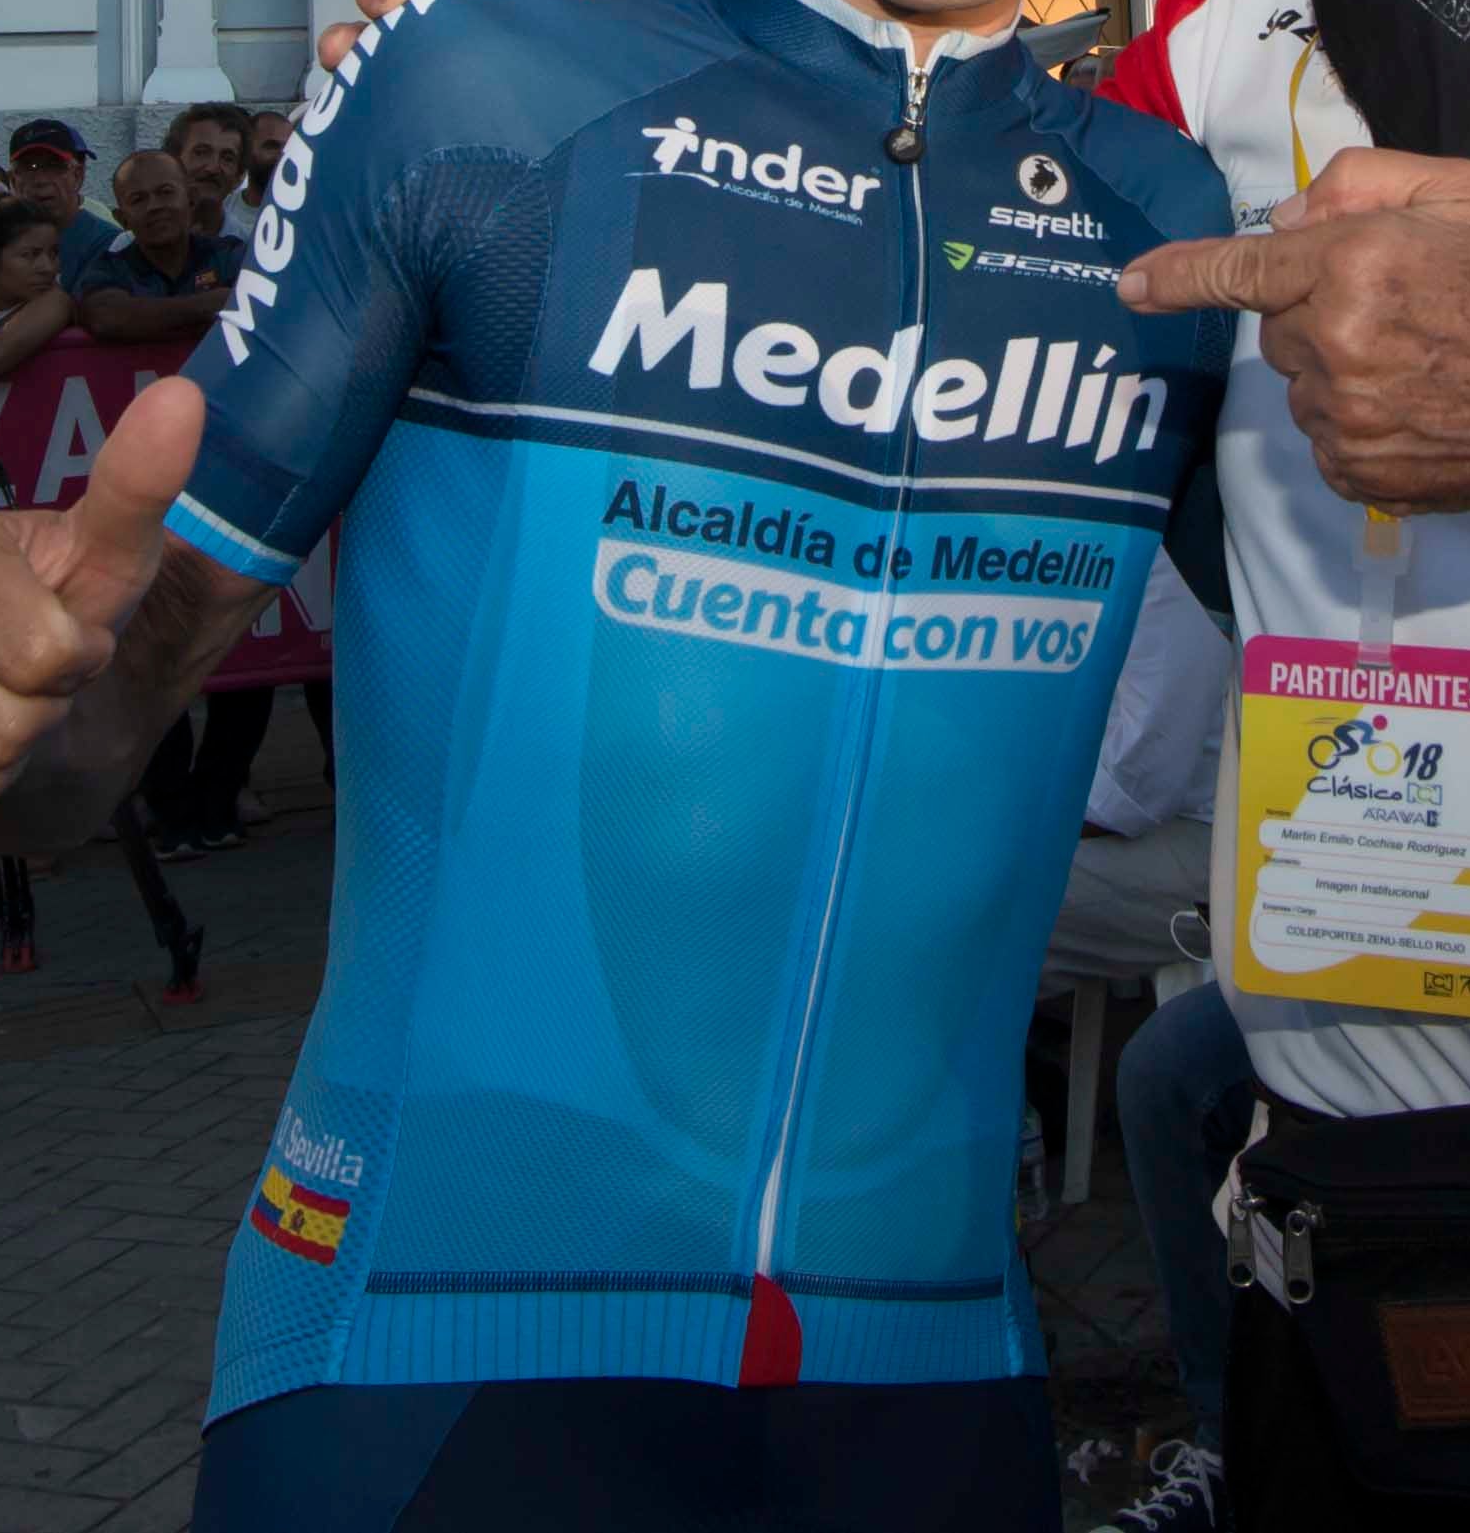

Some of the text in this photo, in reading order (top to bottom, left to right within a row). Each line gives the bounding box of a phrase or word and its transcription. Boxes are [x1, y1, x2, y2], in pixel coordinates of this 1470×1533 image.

[784, 196, 805, 210] de
[988, 205, 1104, 240] safetti
[589, 268, 1168, 466] Medellín
[602, 480, 1116, 590] Alcaldía de Medellín
[606, 553, 1089, 665] Cuenta con vos
[1403, 742, 1443, 780] 18
[1306, 775, 1403, 801] Clásico
[1281, 827, 1316, 842] Martin
[1320, 831, 1354, 846] Emilio
[1358, 835, 1403, 851] Cochise
[1315, 878, 1430, 901] Imagen Institucional
[1286, 924, 1364, 943] COLDEPORTES
[1435, 940, 1466, 954] ROJO
